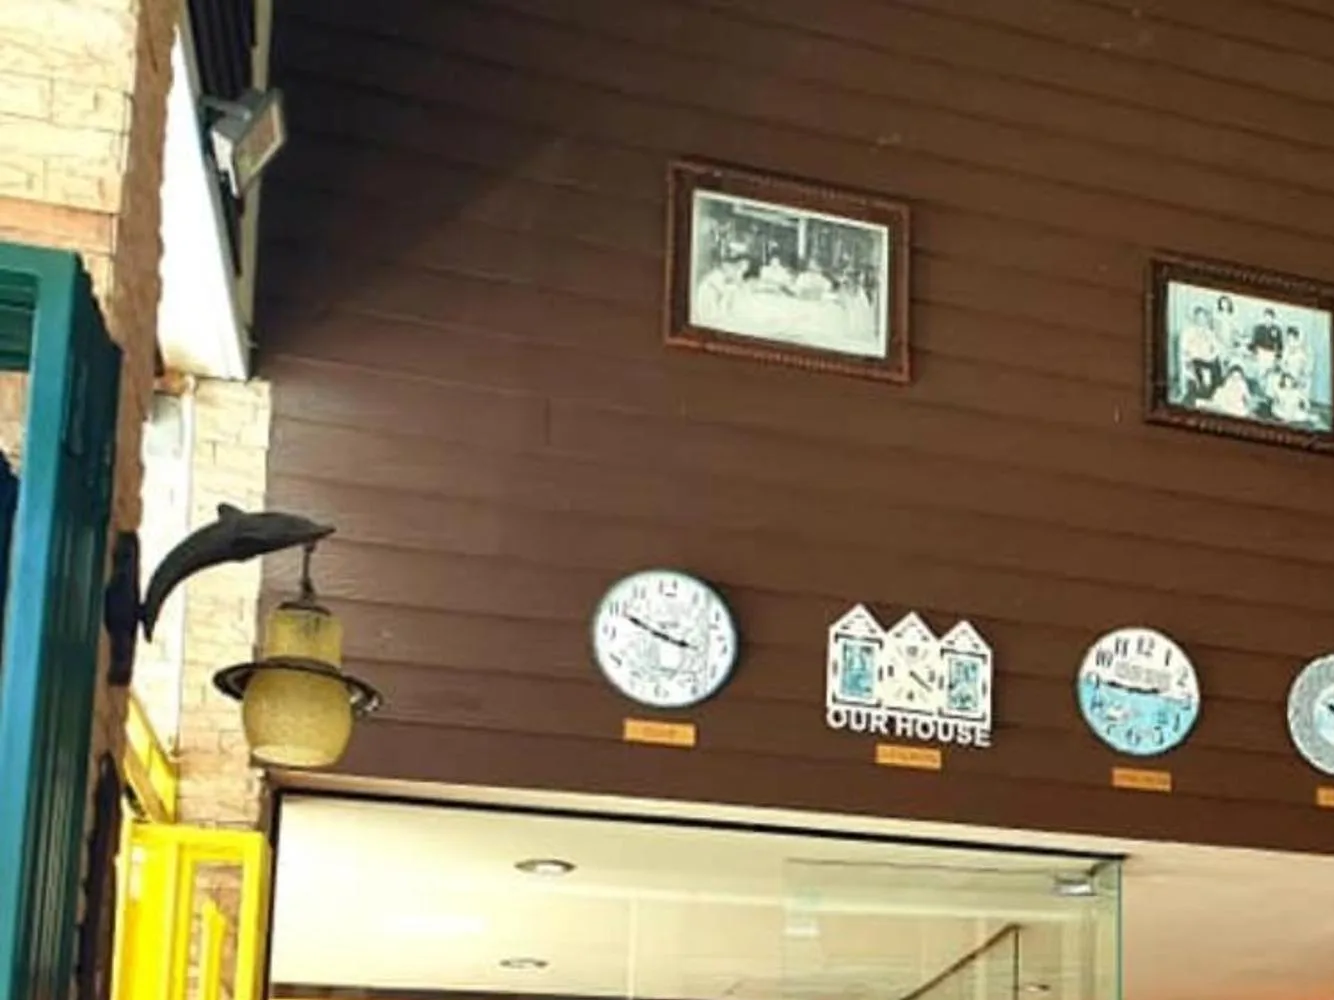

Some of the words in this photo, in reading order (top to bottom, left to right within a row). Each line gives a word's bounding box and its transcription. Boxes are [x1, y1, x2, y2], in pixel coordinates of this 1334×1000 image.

[1115, 637, 1130, 656] 11
[1137, 636, 1155, 659] 12
[1096, 650, 1114, 667] 10
[1165, 648, 1173, 666] 1
[826, 709, 888, 734] OUR
[895, 716, 992, 748] HOUSE
